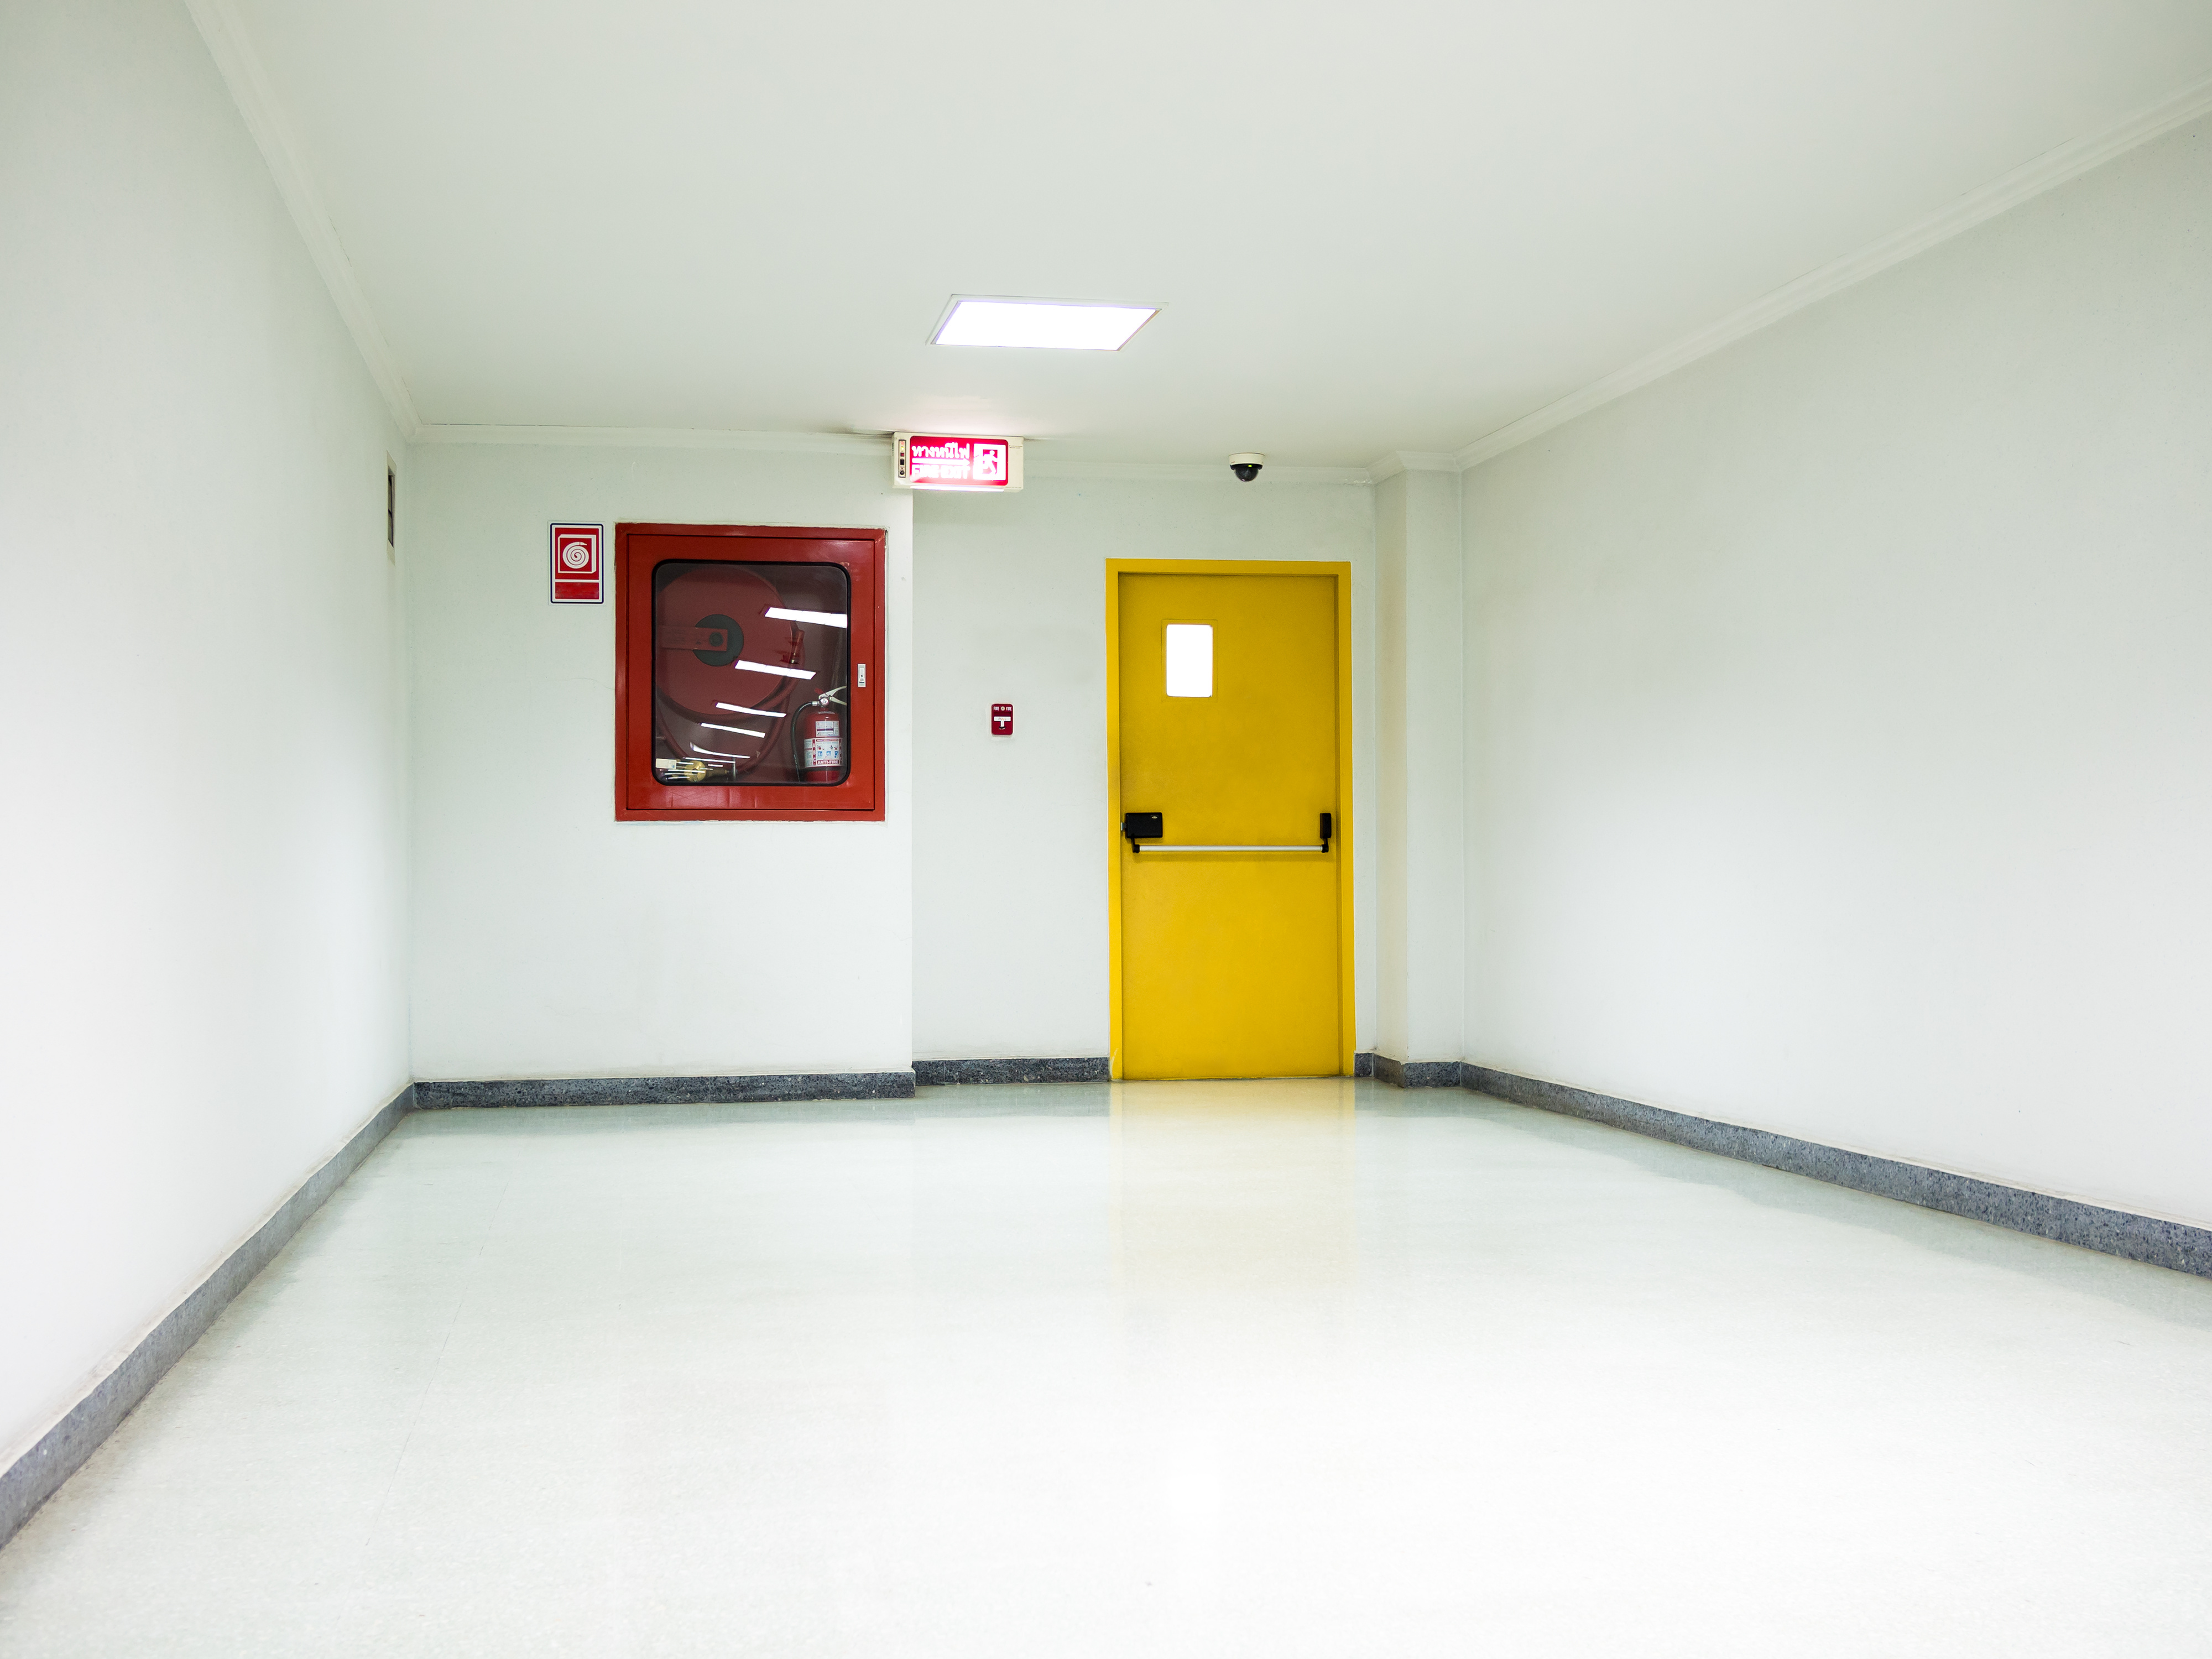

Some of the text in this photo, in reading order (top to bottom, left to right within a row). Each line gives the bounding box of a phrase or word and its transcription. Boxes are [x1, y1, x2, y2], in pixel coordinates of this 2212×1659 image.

[911, 442, 970, 459] ทางหนีไฟ
[912, 465, 971, 479] FIRE EXIT
